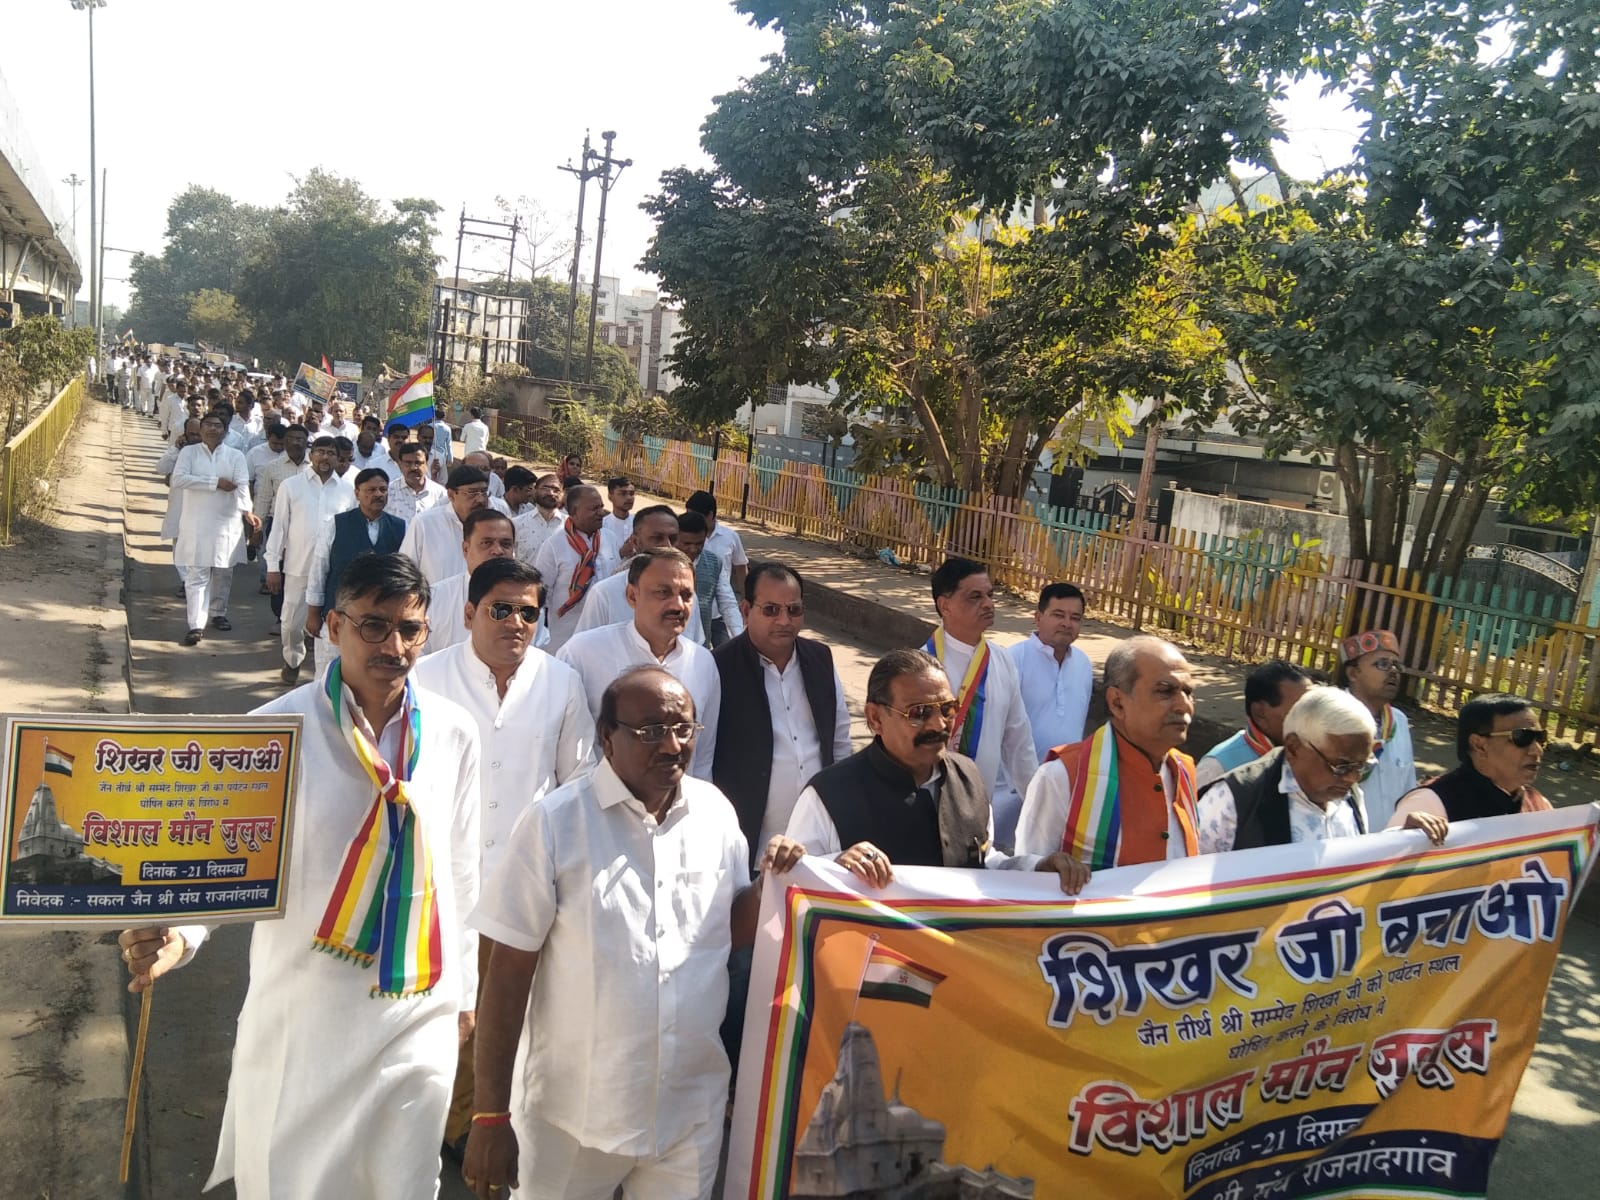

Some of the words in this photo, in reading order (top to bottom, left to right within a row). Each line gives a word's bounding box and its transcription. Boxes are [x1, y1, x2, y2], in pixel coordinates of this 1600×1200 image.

[95, 739, 165, 774] शिखर
[170, 740, 203, 774] जी
[207, 740, 283, 774] बचाओ
[82, 811, 162, 847] विशाल
[168, 810, 214, 846] मौन
[220, 816, 277, 853] जुलूस
[142, 863, 178, 880] दिनांक
[181, 865, 201, 879] -21
[207, 860, 246, 877] दिसम्बर
[16, 890, 64, 908] निवेदक
[87, 893, 125, 907] सकल
[131, 889, 151, 906] जैन
[157, 889, 174, 905] श्री
[179, 888, 201, 904] संघ
[205, 886, 270, 904] राजनांदगांव
[1038, 930, 1264, 1028] शिखर
[1275, 898, 1364, 984] जी
[1378, 857, 1567, 958] बचाओ
[1137, 1019, 1169, 1048] जैन
[1175, 1010, 1212, 1041] तीर्थ
[1220, 1006, 1243, 1034] श्री
[1251, 999, 1297, 1028] सम्मेद
[1301, 988, 1340, 1015] शिखर
[1346, 979, 1362, 1000] जी
[1366, 971, 1383, 994] को
[1387, 962, 1423, 985] पर्यटन
[1427, 954, 1461, 977] स्थल
[1228, 1035, 1272, 1061] घोषित
[1275, 1020, 1308, 1044] करने
[1313, 1014, 1333, 1034] के
[1334, 1004, 1372, 1027] विरोध
[1070, 1071, 1256, 1155] विशाल
[1260, 1035, 1361, 1102] मौन
[1188, 1141, 1246, 1184] दिनांक
[1251, 1129, 1286, 1155] -21
[1303, 1136, 1457, 1187] राजनांदगांव
